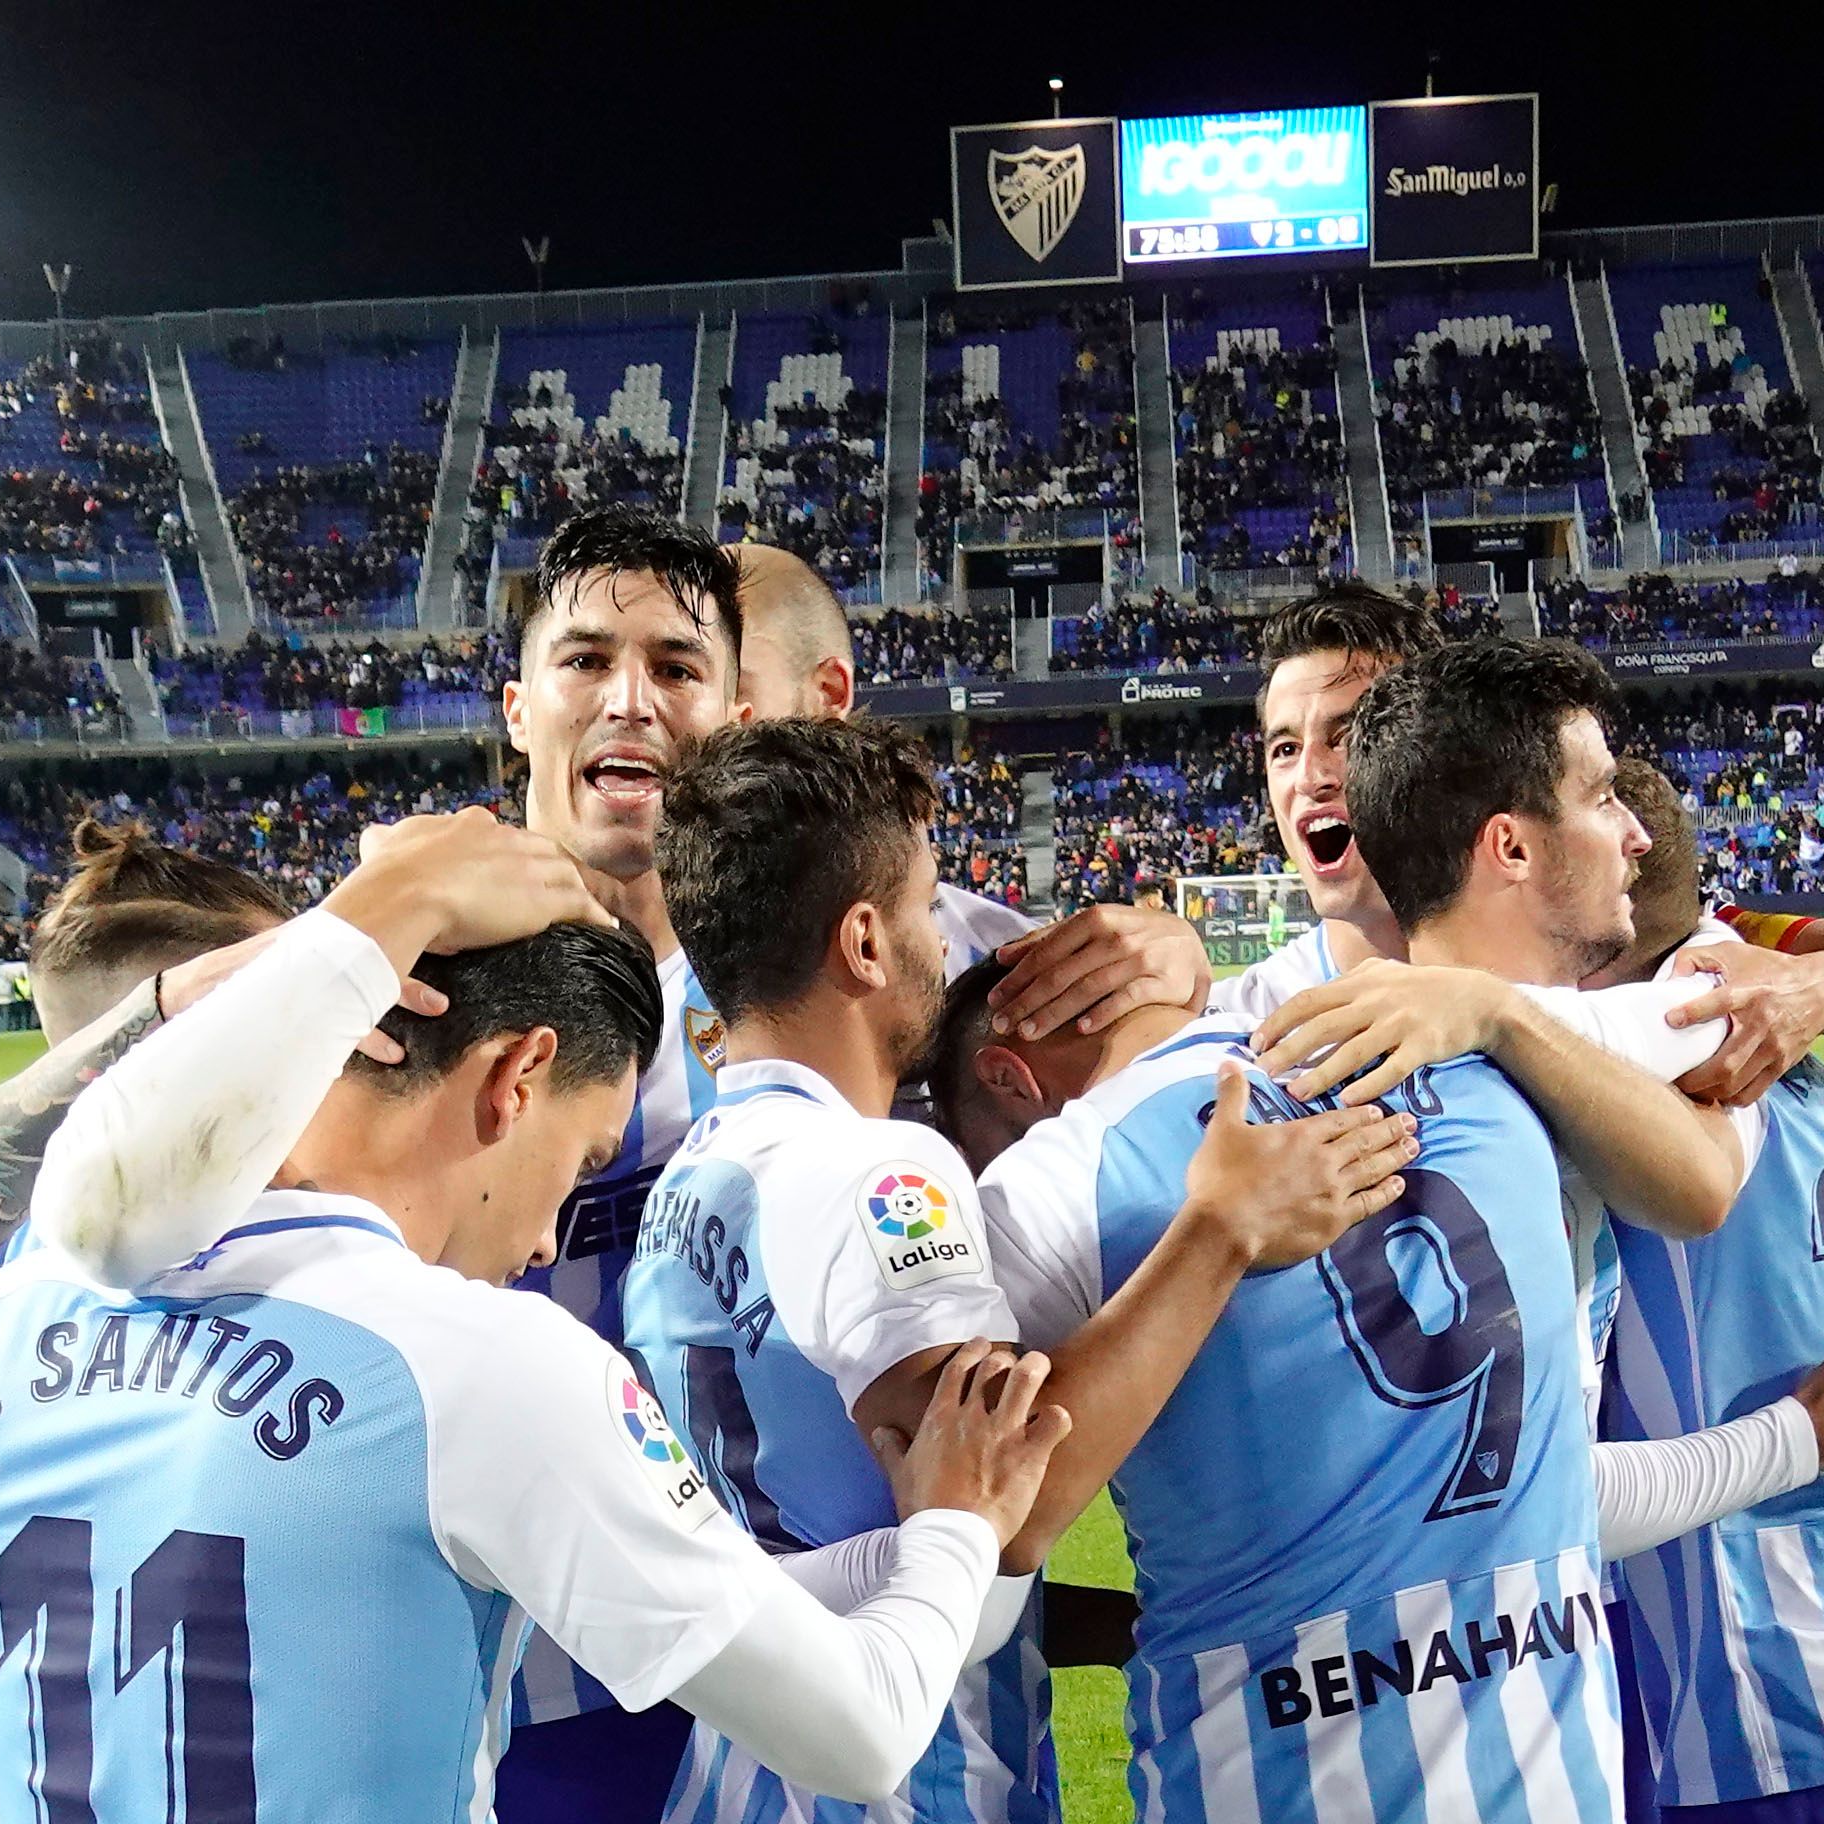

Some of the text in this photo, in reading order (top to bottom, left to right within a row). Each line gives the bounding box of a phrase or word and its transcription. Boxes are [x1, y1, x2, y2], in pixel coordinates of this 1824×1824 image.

[1385, 163, 1499, 197] SanMiguel
[1141, 686, 1203, 700] PROTEC
[888, 1237, 970, 1275] LaLiga
[1316, 1168, 1525, 1524] 9
[30, 1311, 345, 1463] SANTOS
[667, 1471, 706, 1509] LaL
[1259, 1592, 1599, 1729] BENAHAVI
